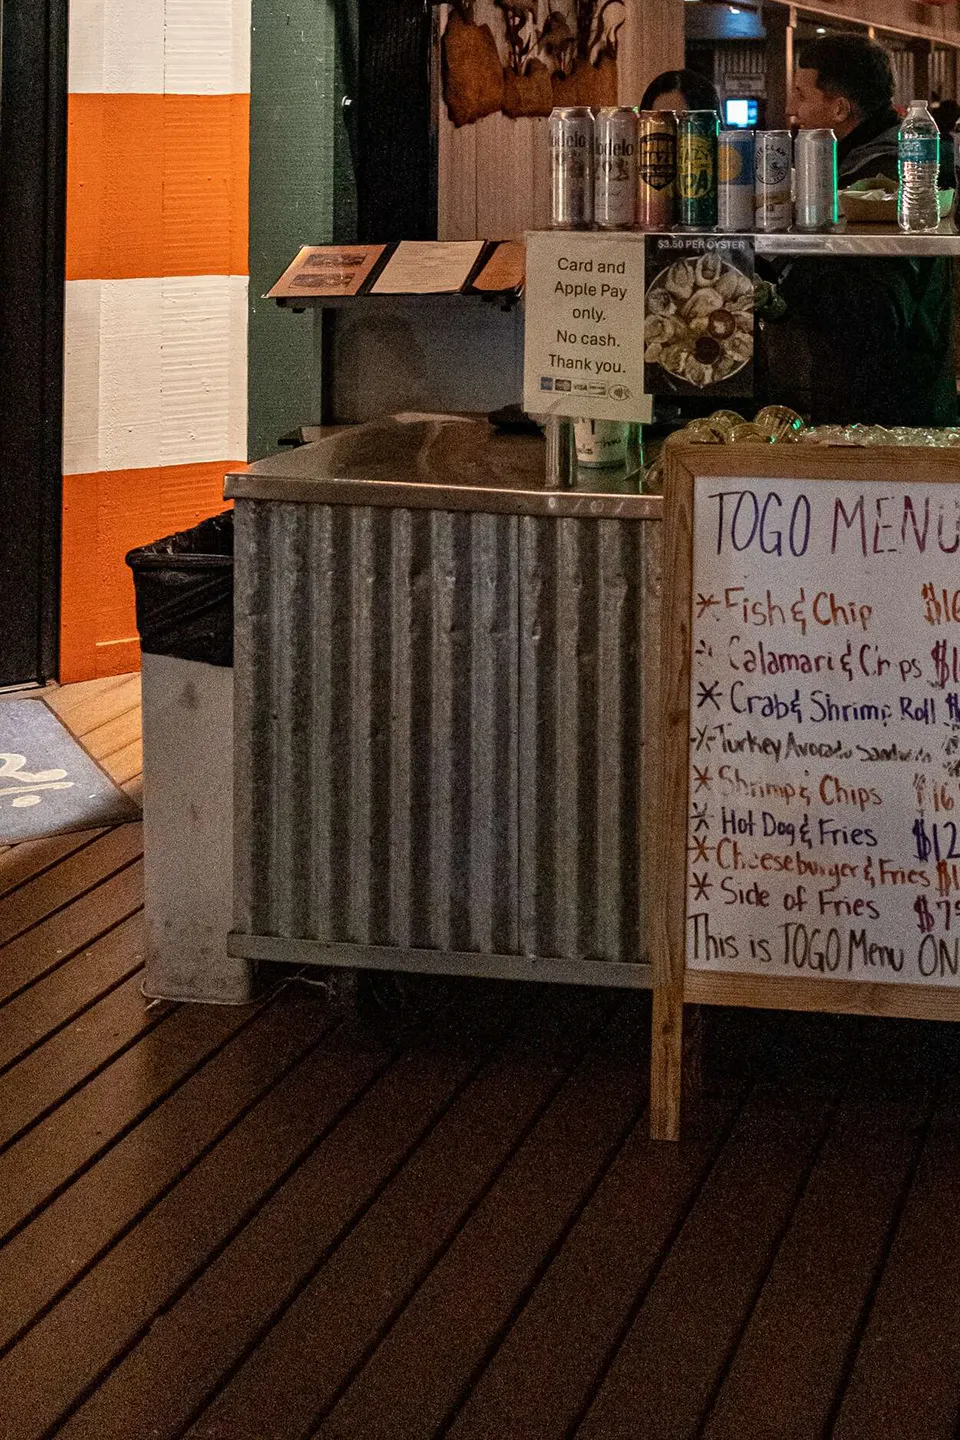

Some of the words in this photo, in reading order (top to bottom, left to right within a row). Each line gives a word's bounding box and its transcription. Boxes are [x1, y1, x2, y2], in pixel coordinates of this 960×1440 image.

[686, 241, 705, 250] PER
[707, 241, 746, 250] OYSTER
[557, 258, 593, 273] Card
[597, 261, 626, 274] and
[554, 281, 597, 298] Apple
[601, 284, 628, 301] Pay
[572, 308, 606, 323] only.
[557, 330, 577, 344] No
[581, 333, 620, 348] cash.
[549, 354, 592, 371] Thank
[595, 360, 626, 374] you.
[708, 490, 811, 556] TOGO
[725, 587, 786, 627] Fish
[813, 591, 872, 631] Chip
[729, 635, 834, 675] Calamari
[860, 644, 922, 682] Chps
[900, 696, 936, 725] Roll
[820, 773, 882, 812] Chips
[721, 806, 756, 837] Hot
[762, 811, 796, 847] Dog
[818, 818, 878, 848] Fries
[879, 858, 931, 887] Fries
[720, 876, 770, 908] Side
[783, 885, 808, 912] of
[818, 886, 880, 920] Fries
[687, 912, 739, 961] This
[748, 934, 772, 963] is
[778, 922, 841, 972] TOGO
[847, 928, 904, 972] Menu
